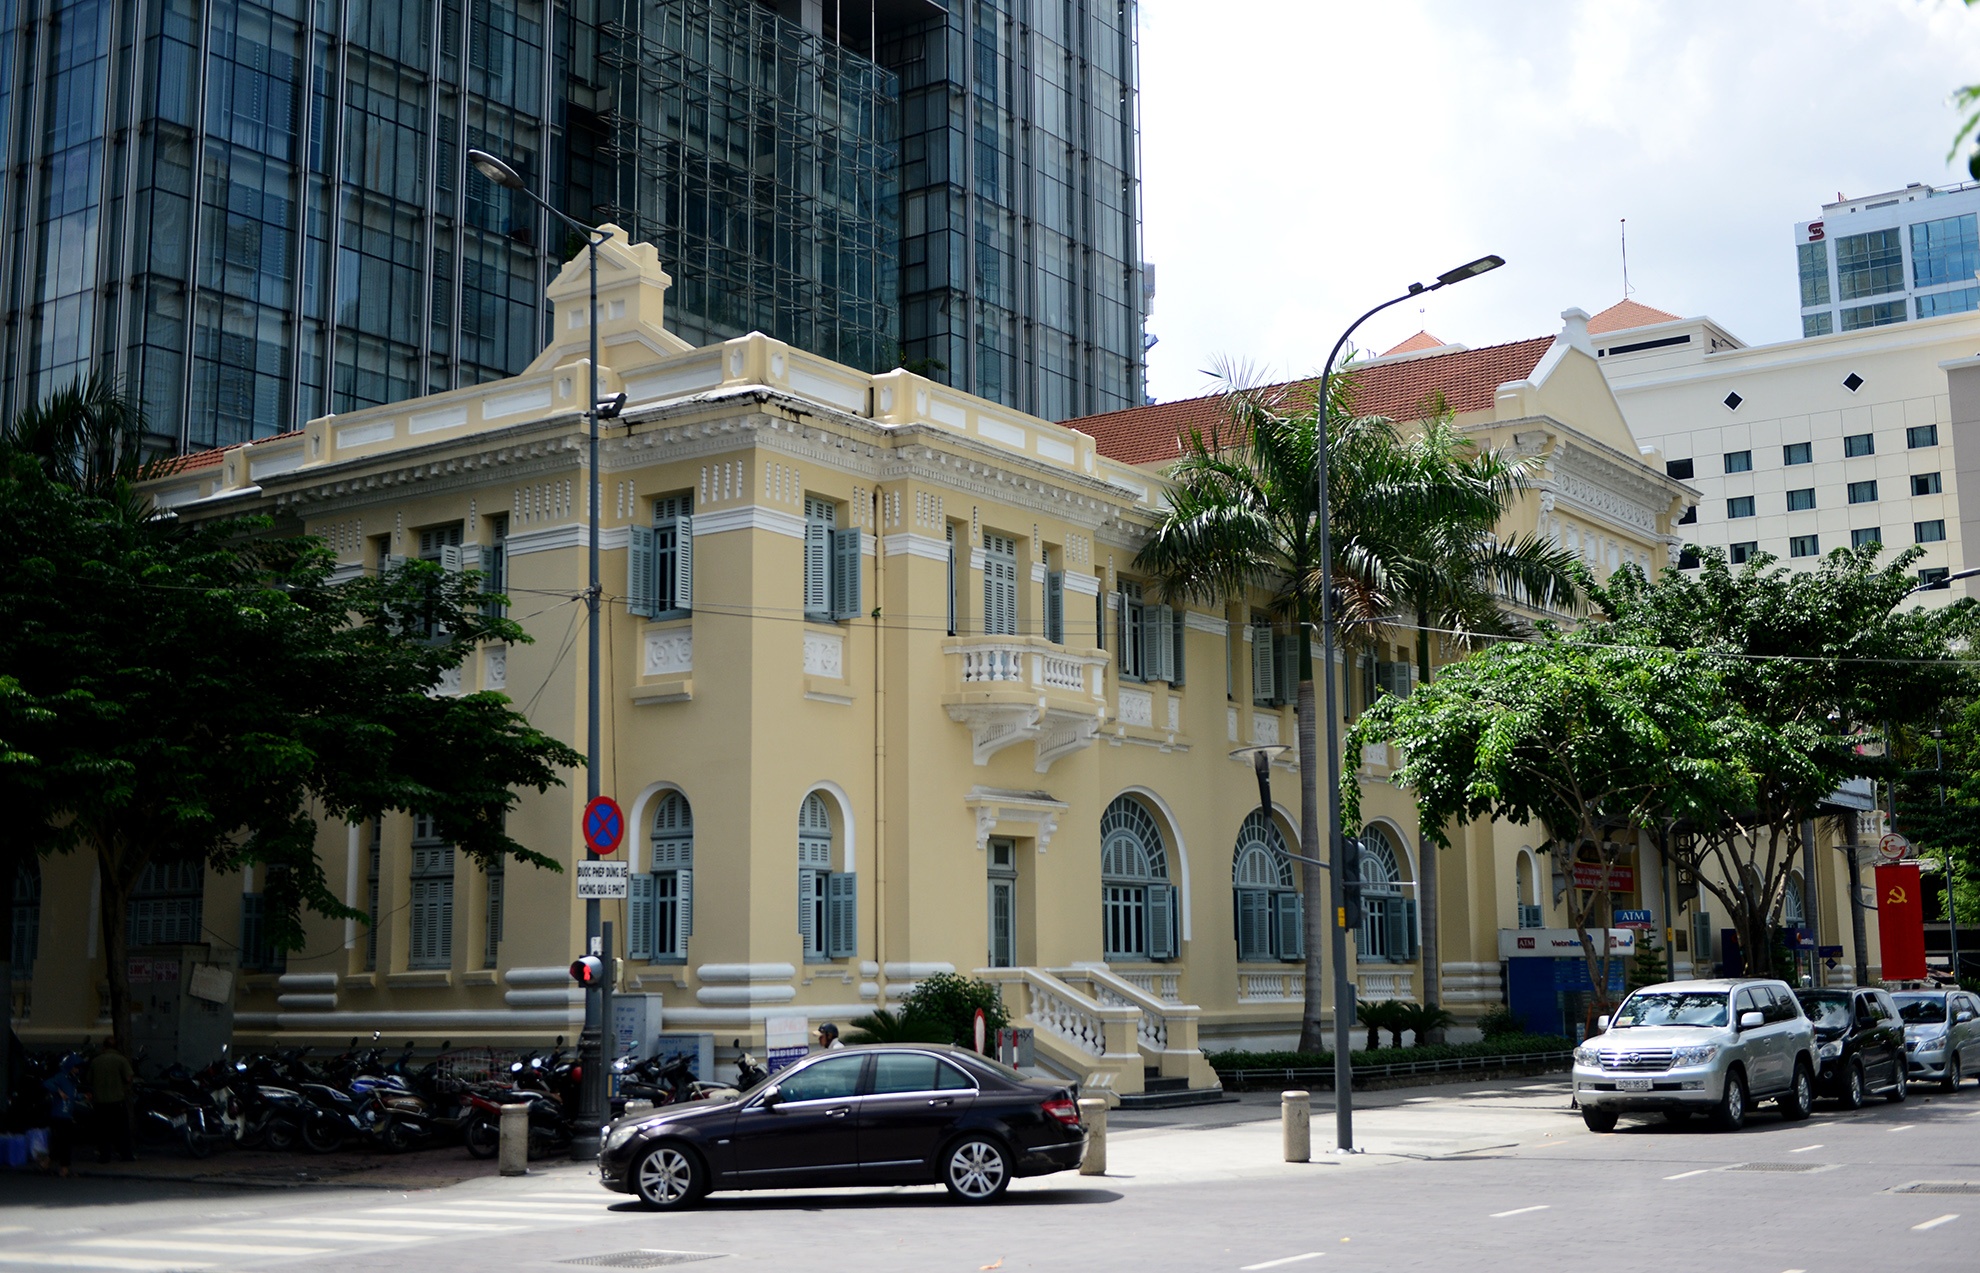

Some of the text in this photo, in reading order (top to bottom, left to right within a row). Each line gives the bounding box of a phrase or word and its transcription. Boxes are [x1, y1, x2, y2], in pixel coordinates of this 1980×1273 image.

[620, 866, 628, 878] XE
[579, 881, 596, 895] KHÔNG
[612, 881, 625, 895] PHÚT
[1622, 911, 1645, 921] ATM
[1519, 939, 1535, 948] ATM
